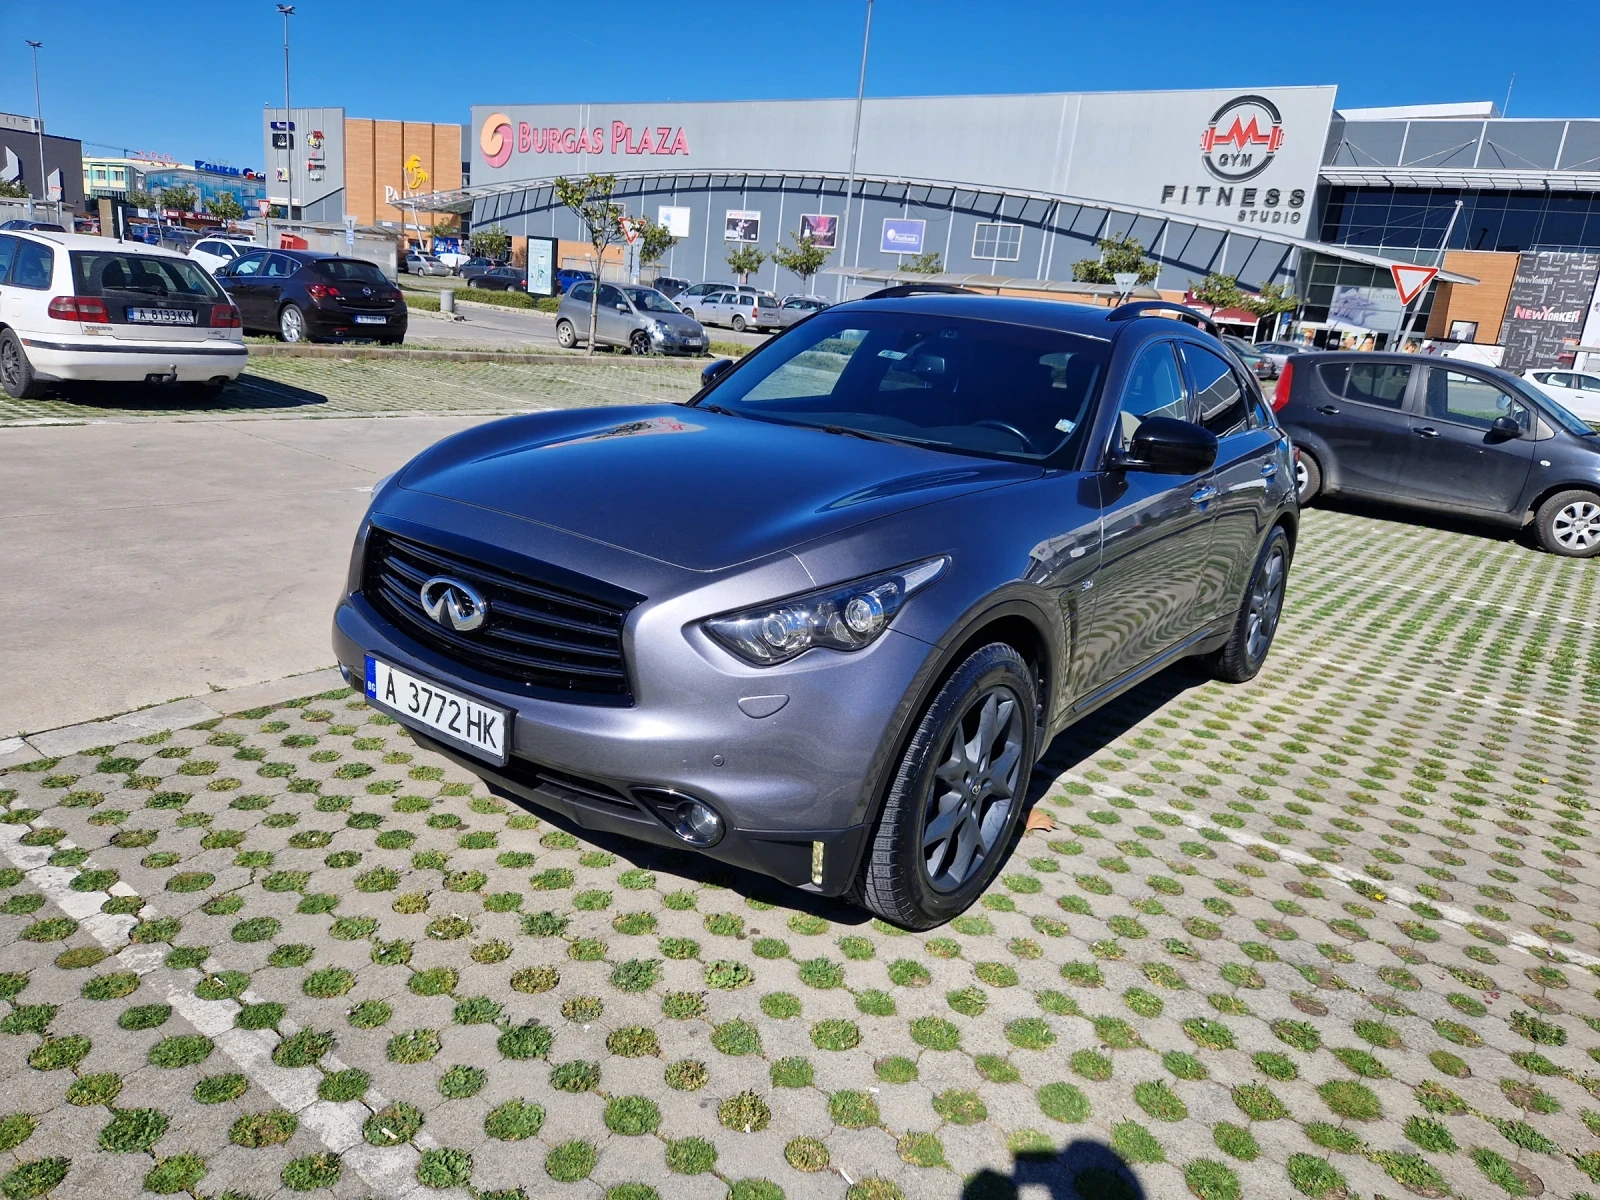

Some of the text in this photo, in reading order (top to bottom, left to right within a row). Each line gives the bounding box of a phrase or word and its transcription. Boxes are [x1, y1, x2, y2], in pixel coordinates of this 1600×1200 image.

[519, 120, 690, 155] BURGAS PLAZA
[1218, 153, 1253, 167] GYM
[204, 163, 240, 175] DAIKIN
[1161, 185, 1305, 208] FITNESS
[1238, 210, 1301, 224] STUDIO
[139, 309, 146, 319] A
[367, 680, 376, 692] BG
[385, 671, 397, 704] A
